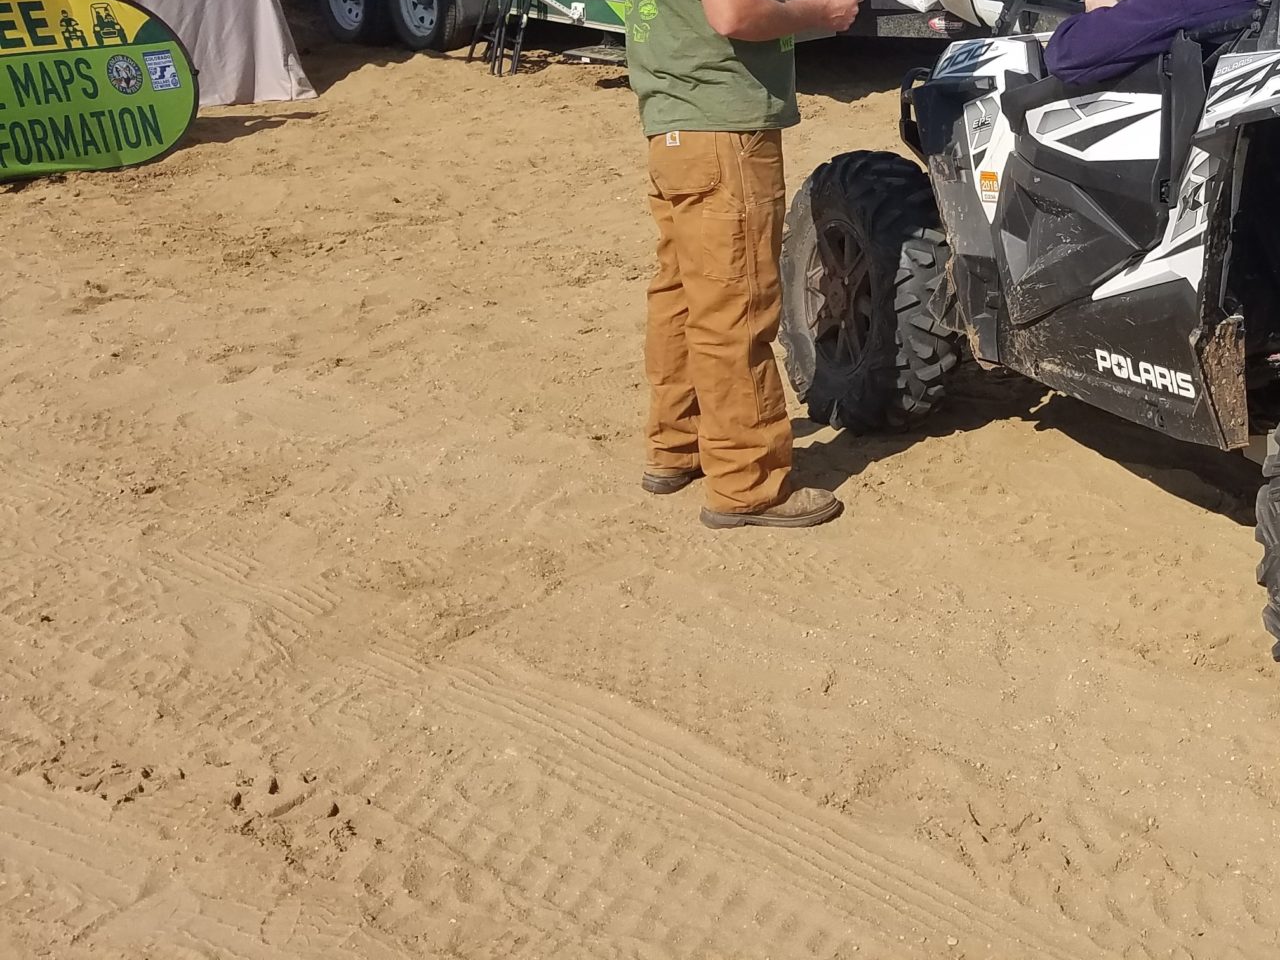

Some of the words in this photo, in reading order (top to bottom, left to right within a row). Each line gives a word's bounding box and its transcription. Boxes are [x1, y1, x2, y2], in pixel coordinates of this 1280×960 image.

[6, 57, 99, 108] MAPS
[1213, 56, 1254, 77] POLARIS
[972, 115, 993, 130] EPS
[1095, 348, 1196, 399] POLARIS
